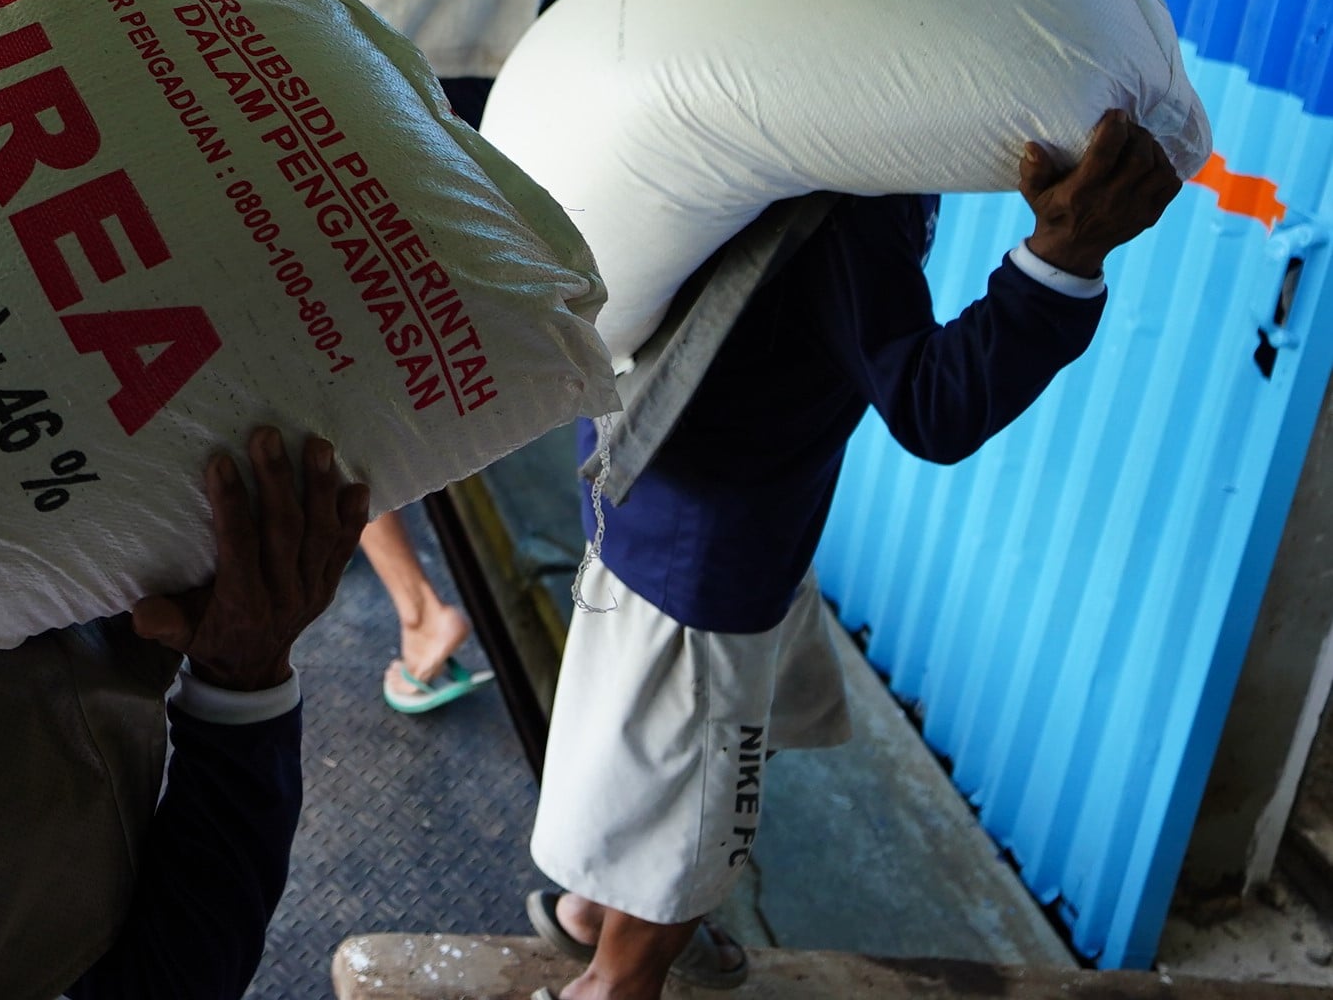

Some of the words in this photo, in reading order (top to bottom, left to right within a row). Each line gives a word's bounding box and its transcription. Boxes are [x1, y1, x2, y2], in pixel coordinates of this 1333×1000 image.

[120, 10, 233, 164] PENGADUAN
[225, 180, 355, 374] 0800-100-800-1
[173, 3, 279, 123] DALAM
[261, 124, 446, 411] PENGAWASAN
[331, 151, 498, 411] PEMERINTAH
[20, 449, 101, 513] %
[728, 826, 757, 868] FC
[735, 725, 764, 814] NIKE
